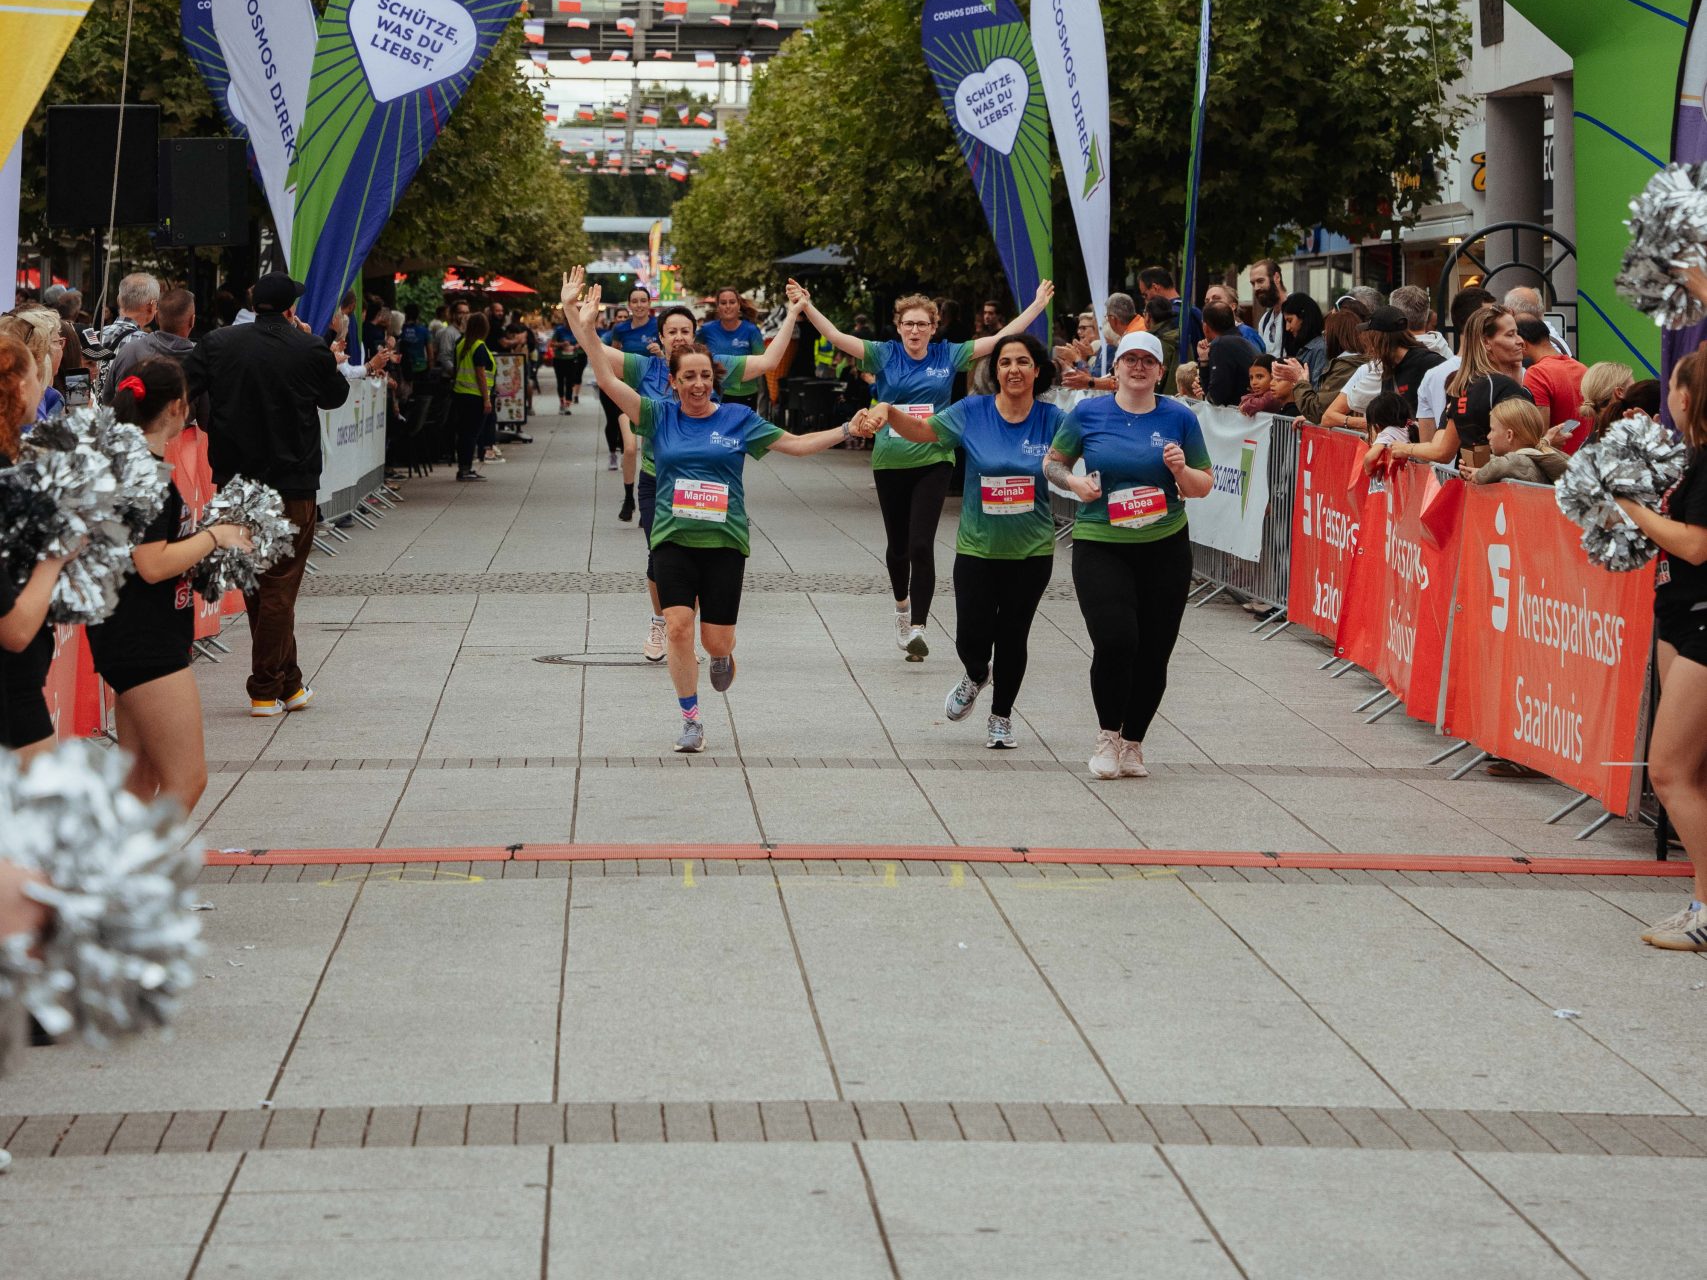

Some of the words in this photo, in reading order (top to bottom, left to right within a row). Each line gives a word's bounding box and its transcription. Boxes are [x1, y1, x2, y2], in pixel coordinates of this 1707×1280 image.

[933, 8, 964, 21] COSMOS
[965, 2, 993, 16] DIREKT
[377, 15, 414, 41] WAS
[417, 34, 443, 54] DU
[370, 33, 434, 72] LIEBST.
[965, 73, 1016, 107] SCHÜTZE,
[972, 99, 996, 117] WAS
[997, 89, 1013, 104] DU
[978, 102, 1017, 129] LIEBST.
[1071, 90, 1094, 174] DIREKT
[684, 490, 718, 502] Marion
[991, 486, 1025, 497] Zeinab
[1120, 498, 1153, 511] Tabea
[1513, 675, 1583, 764] Saarlouis
